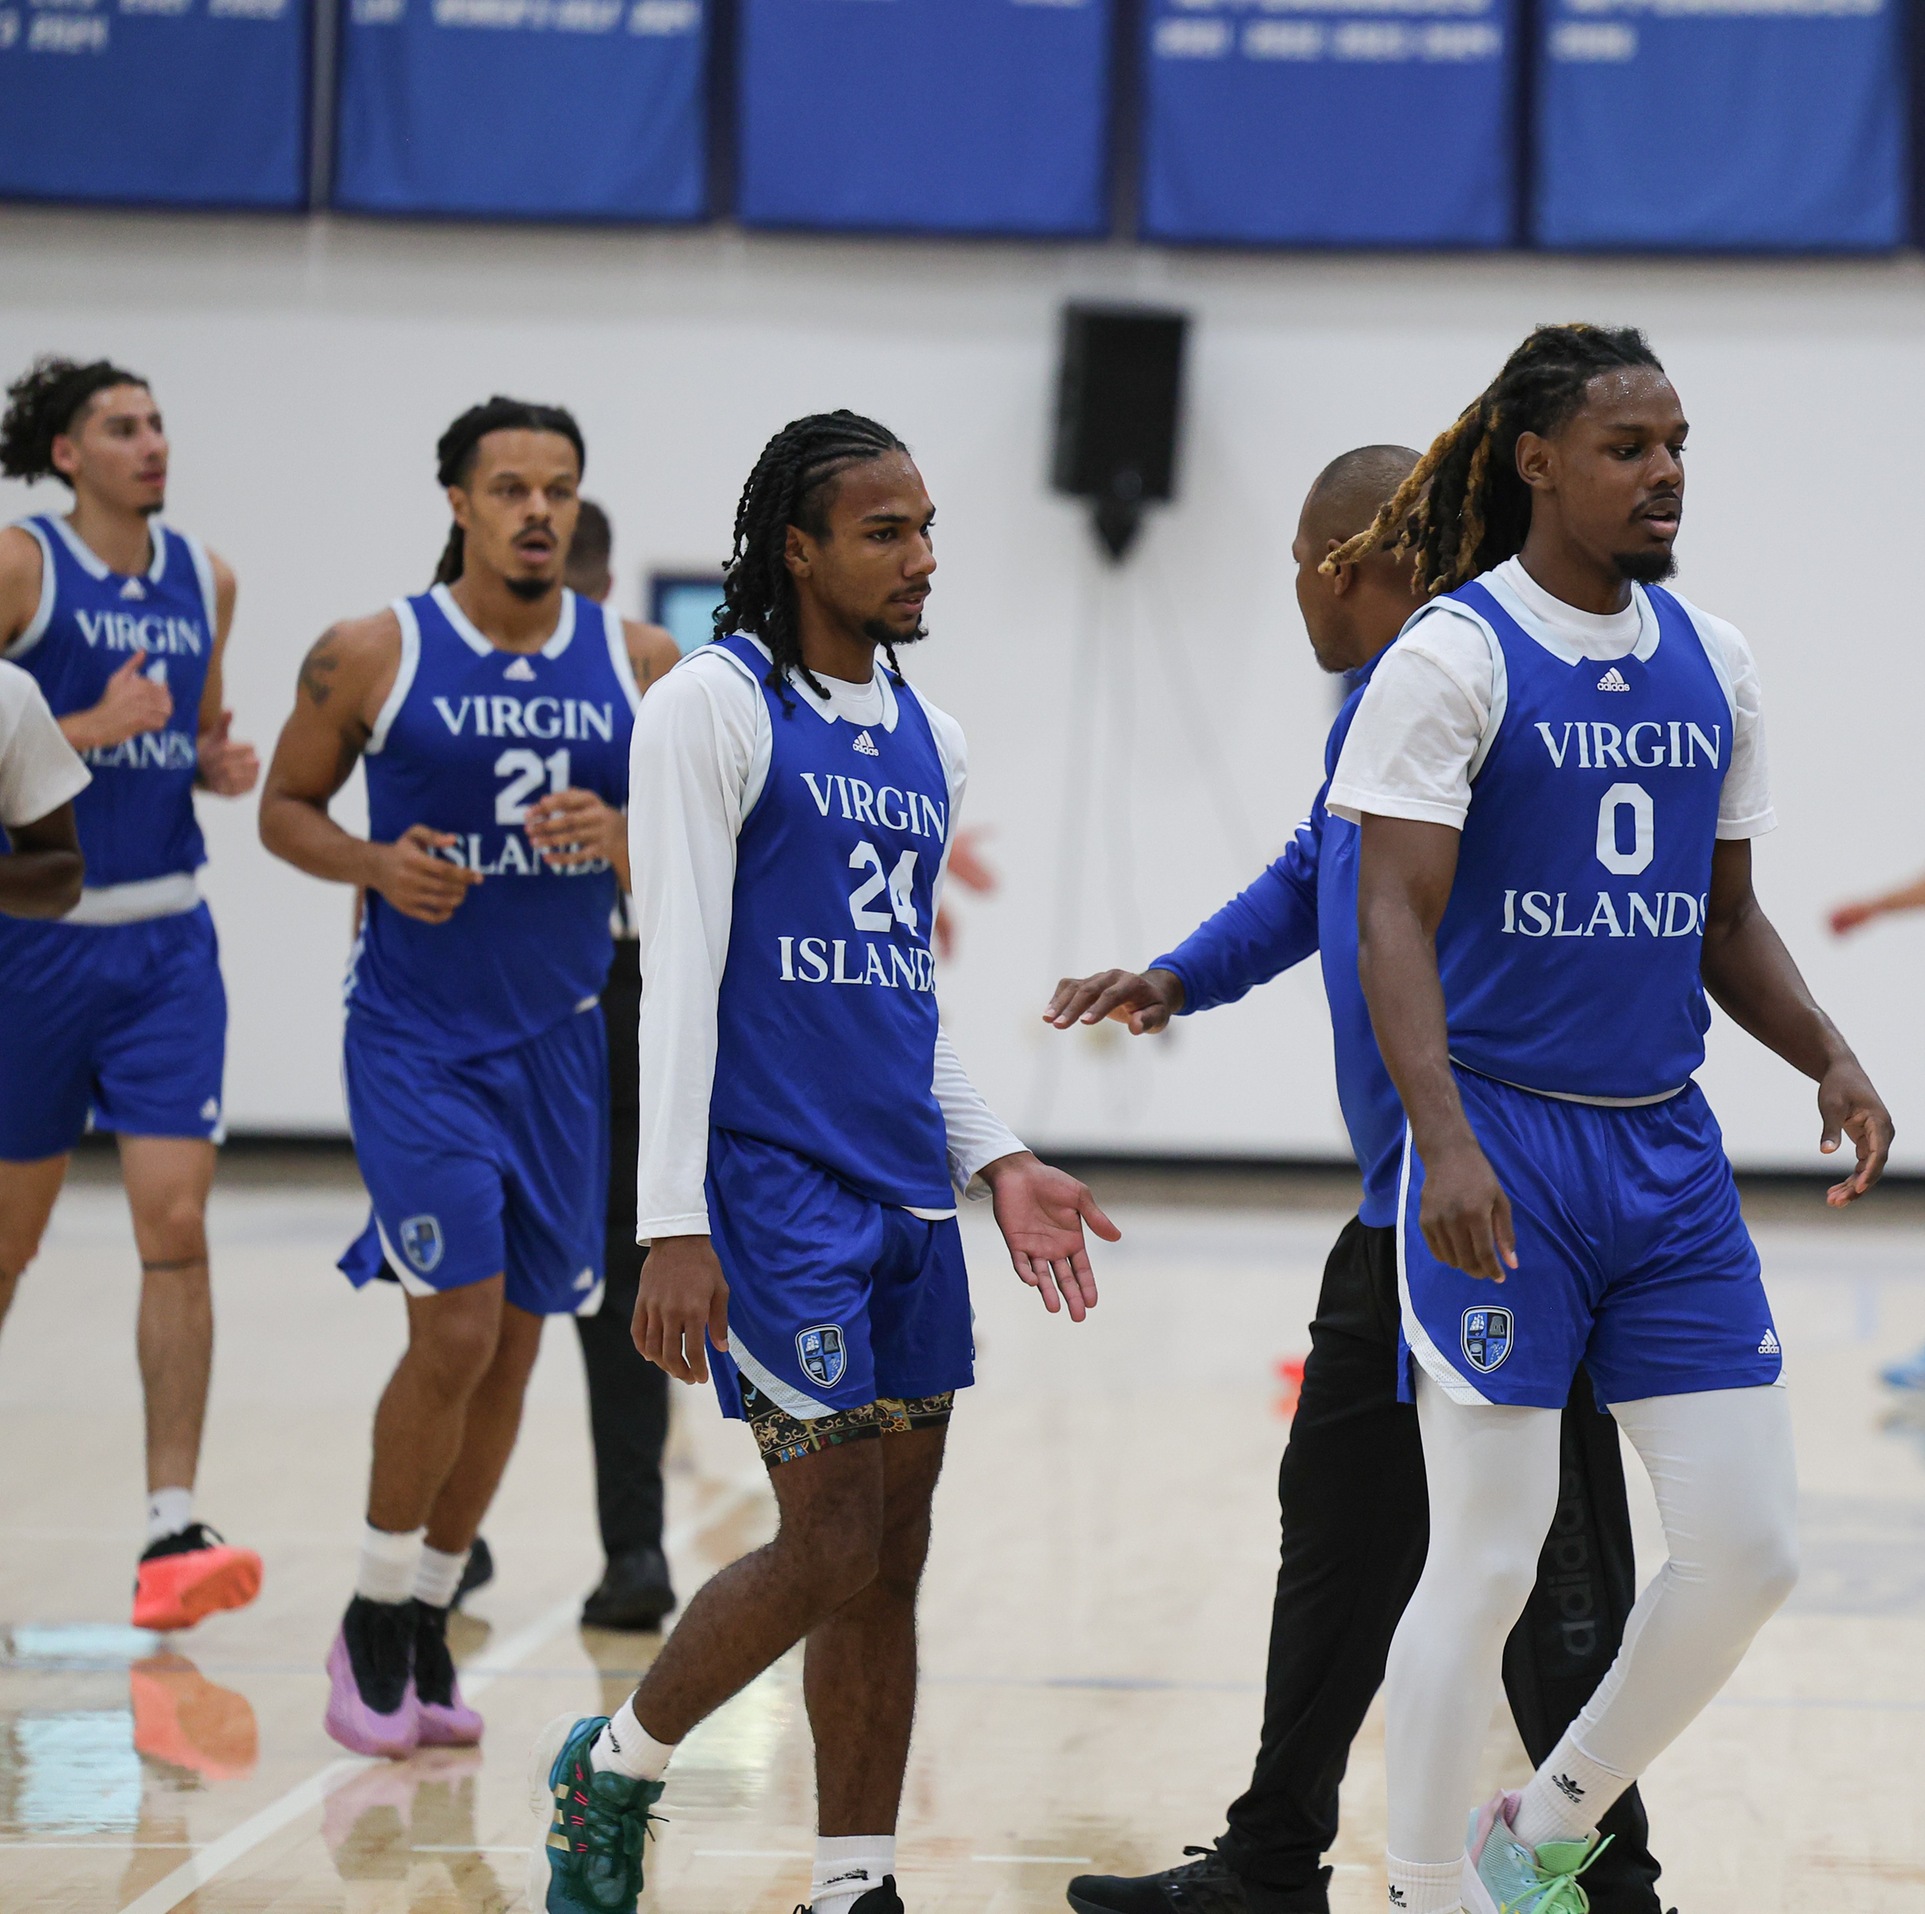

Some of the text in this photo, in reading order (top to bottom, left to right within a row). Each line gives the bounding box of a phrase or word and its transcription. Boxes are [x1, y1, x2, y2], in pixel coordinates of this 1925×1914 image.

[71, 609, 201, 656] VIRGIN
[1596, 680, 1631, 691] adidas
[433, 695, 613, 742] VIRGIN
[1534, 721, 1721, 769] VIRGIN
[494, 748, 570, 826] 21
[801, 772, 945, 843] VIRGIN
[1596, 782, 1654, 876] 0
[848, 840, 919, 936] 24
[777, 936, 936, 993] ISLAND
